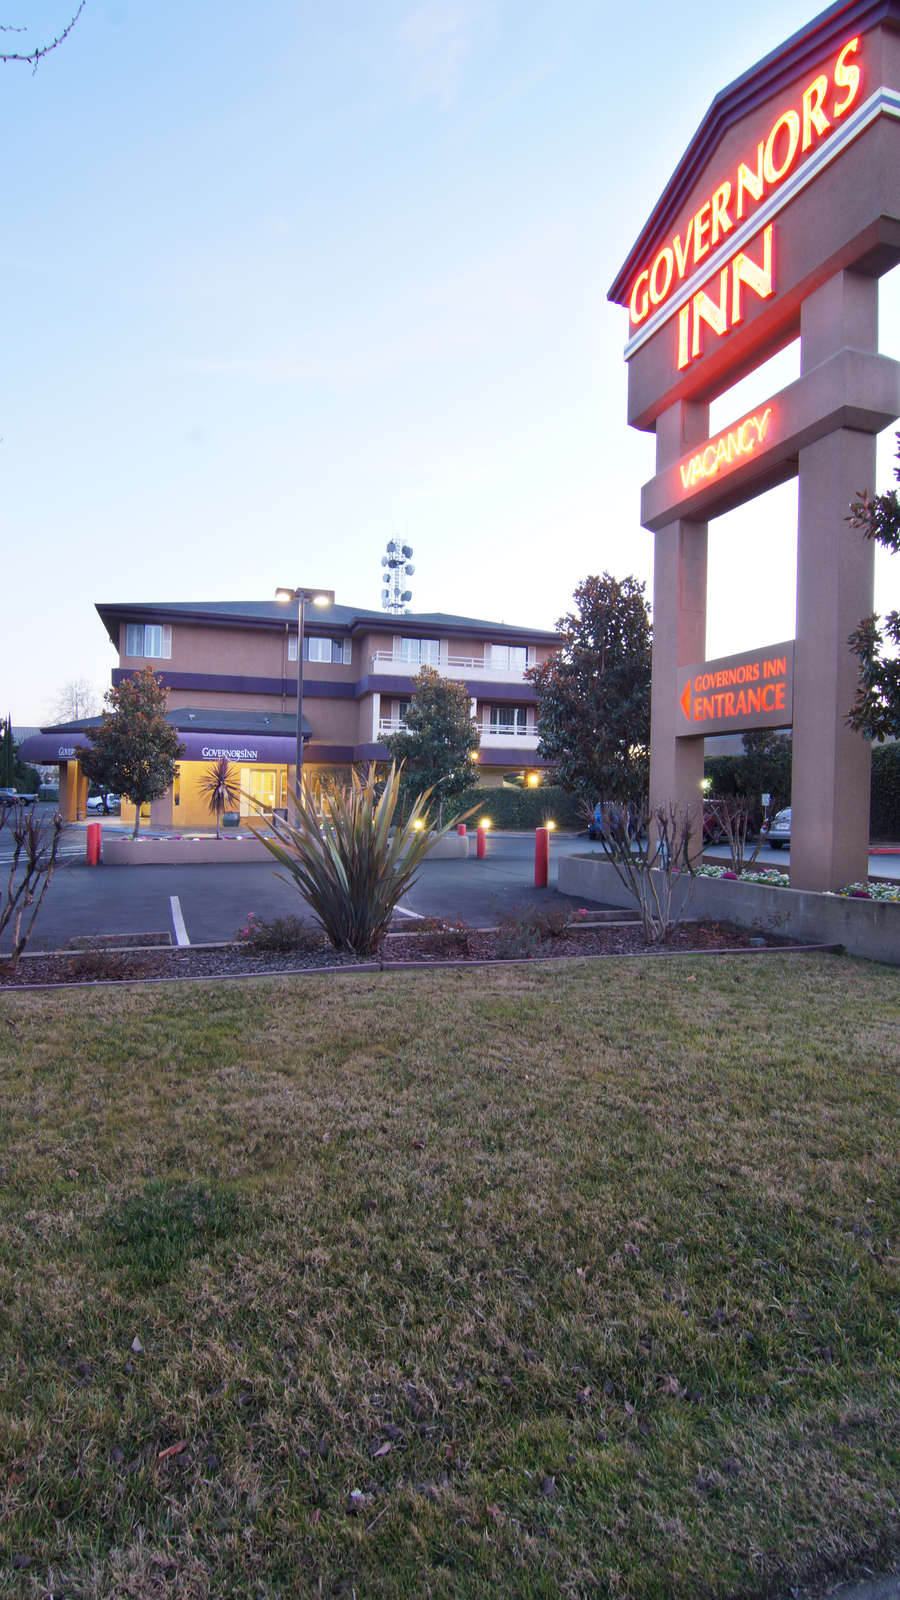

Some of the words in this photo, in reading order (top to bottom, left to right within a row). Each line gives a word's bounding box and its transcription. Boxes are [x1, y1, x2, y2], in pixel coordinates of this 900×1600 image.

[630, 36, 861, 324] GOVERNORS
[677, 223, 775, 371] INN
[680, 408, 772, 488] VACANCY
[694, 662, 760, 692] GOVERNORS
[763, 656, 787, 679] INN
[694, 682, 786, 721] ENTRANCE
